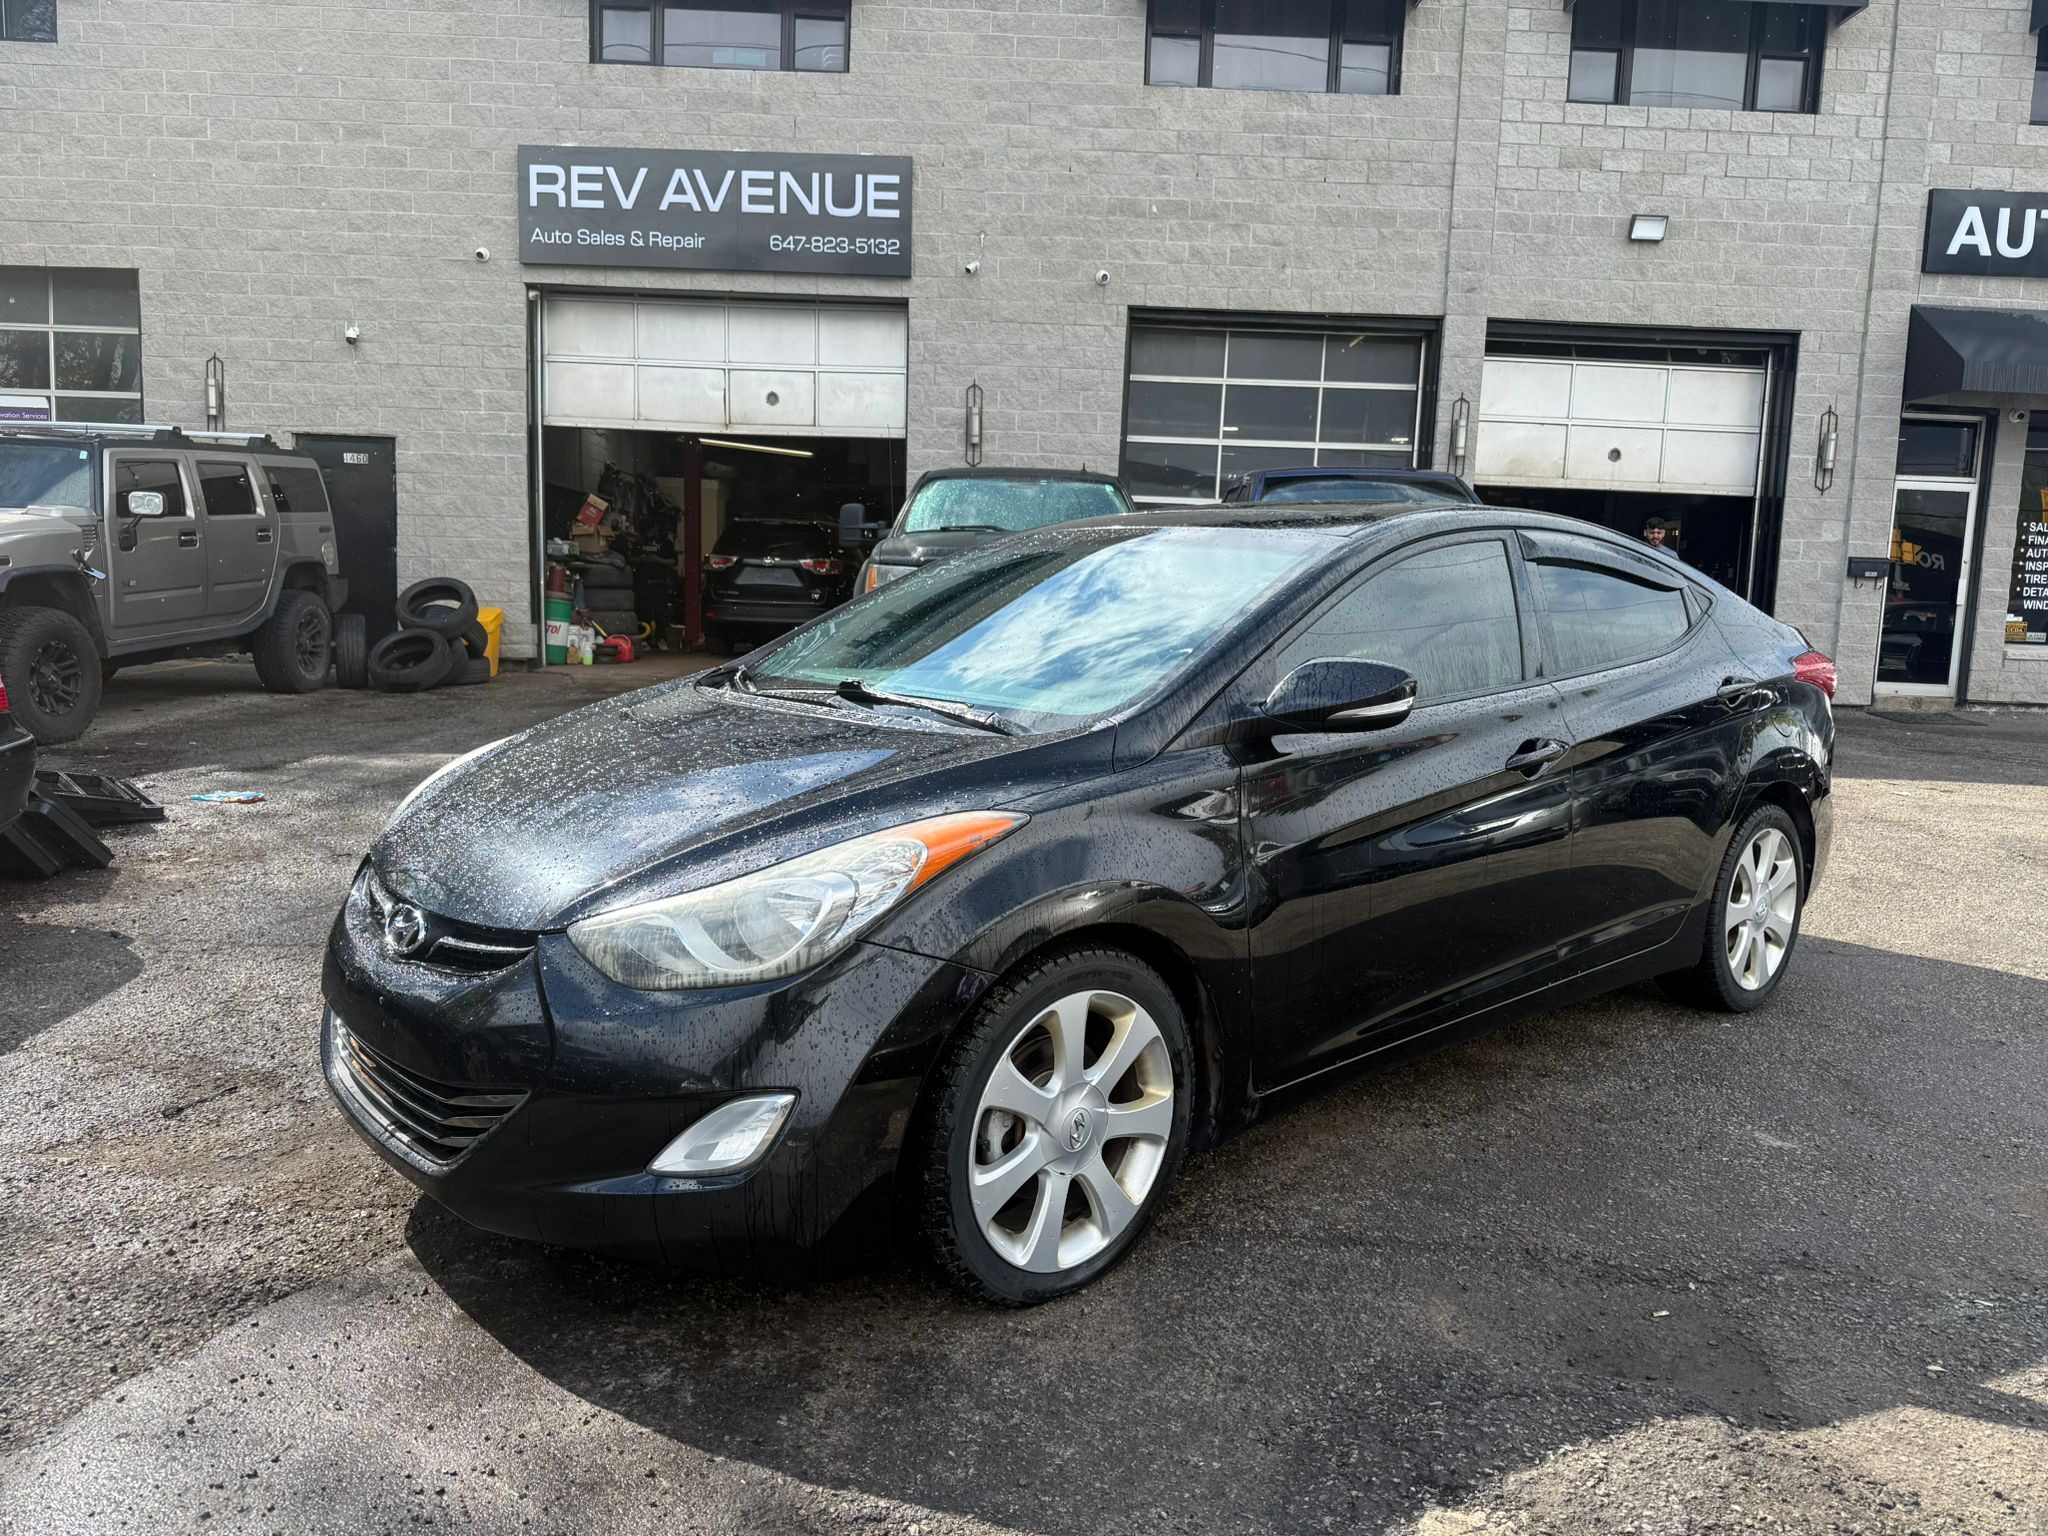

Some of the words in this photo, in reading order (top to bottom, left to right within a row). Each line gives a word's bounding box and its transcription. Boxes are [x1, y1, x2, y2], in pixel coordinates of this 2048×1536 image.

[528, 163, 648, 211] REV
[658, 167, 901, 219] AVENUE
[1945, 205, 2048, 259] AU
[530, 227, 573, 245] Auto
[576, 228, 625, 246] Sales
[630, 230, 645, 247] &
[649, 230, 706, 251] Repair
[769, 234, 900, 255] 647-823-5132
[21, 411, 48, 420] Services
[2029, 521, 2048, 532] SAL
[2025, 547, 2048, 559] AUT
[2025, 561, 2048, 572] INSP
[2023, 599, 2048, 611] WIND
